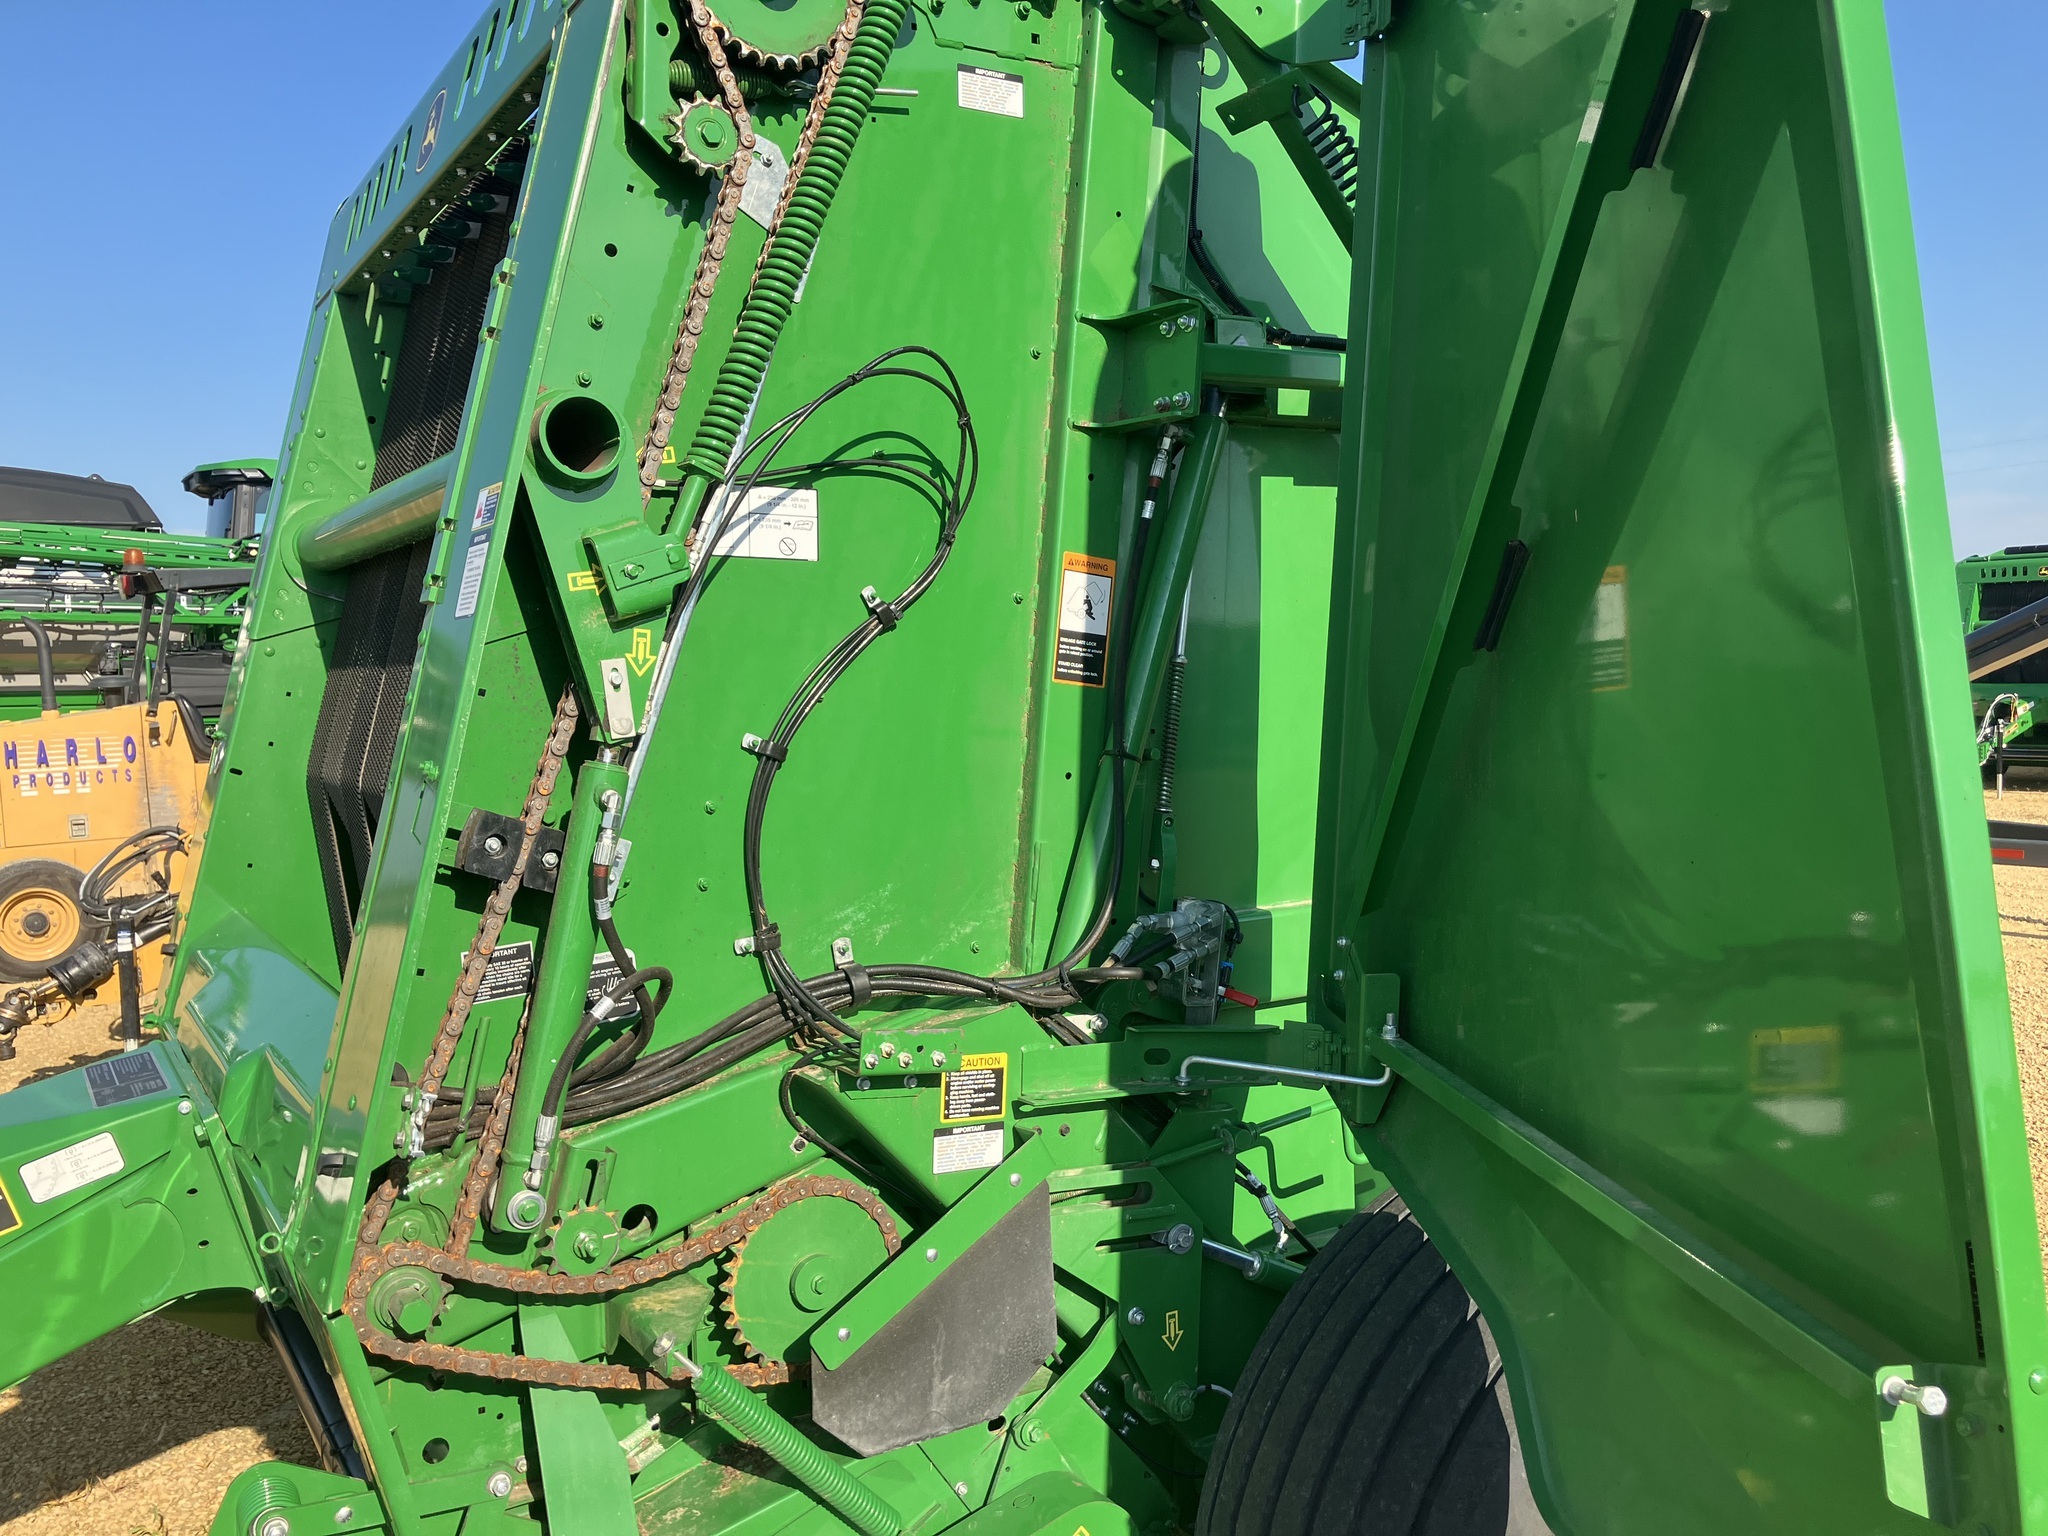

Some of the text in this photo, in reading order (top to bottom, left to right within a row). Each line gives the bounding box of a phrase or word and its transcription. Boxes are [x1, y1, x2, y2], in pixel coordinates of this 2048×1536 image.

[976, 68, 1005, 79] IMPORTANT
[1074, 559, 1108, 571] WARNING
[4, 736, 136, 770] HARLO
[12, 769, 132, 788] PRODUCTS
[492, 948, 517, 957] ORTANT
[961, 1057, 1000, 1067] CAUTION
[953, 1125, 985, 1134] IMPORTANT
